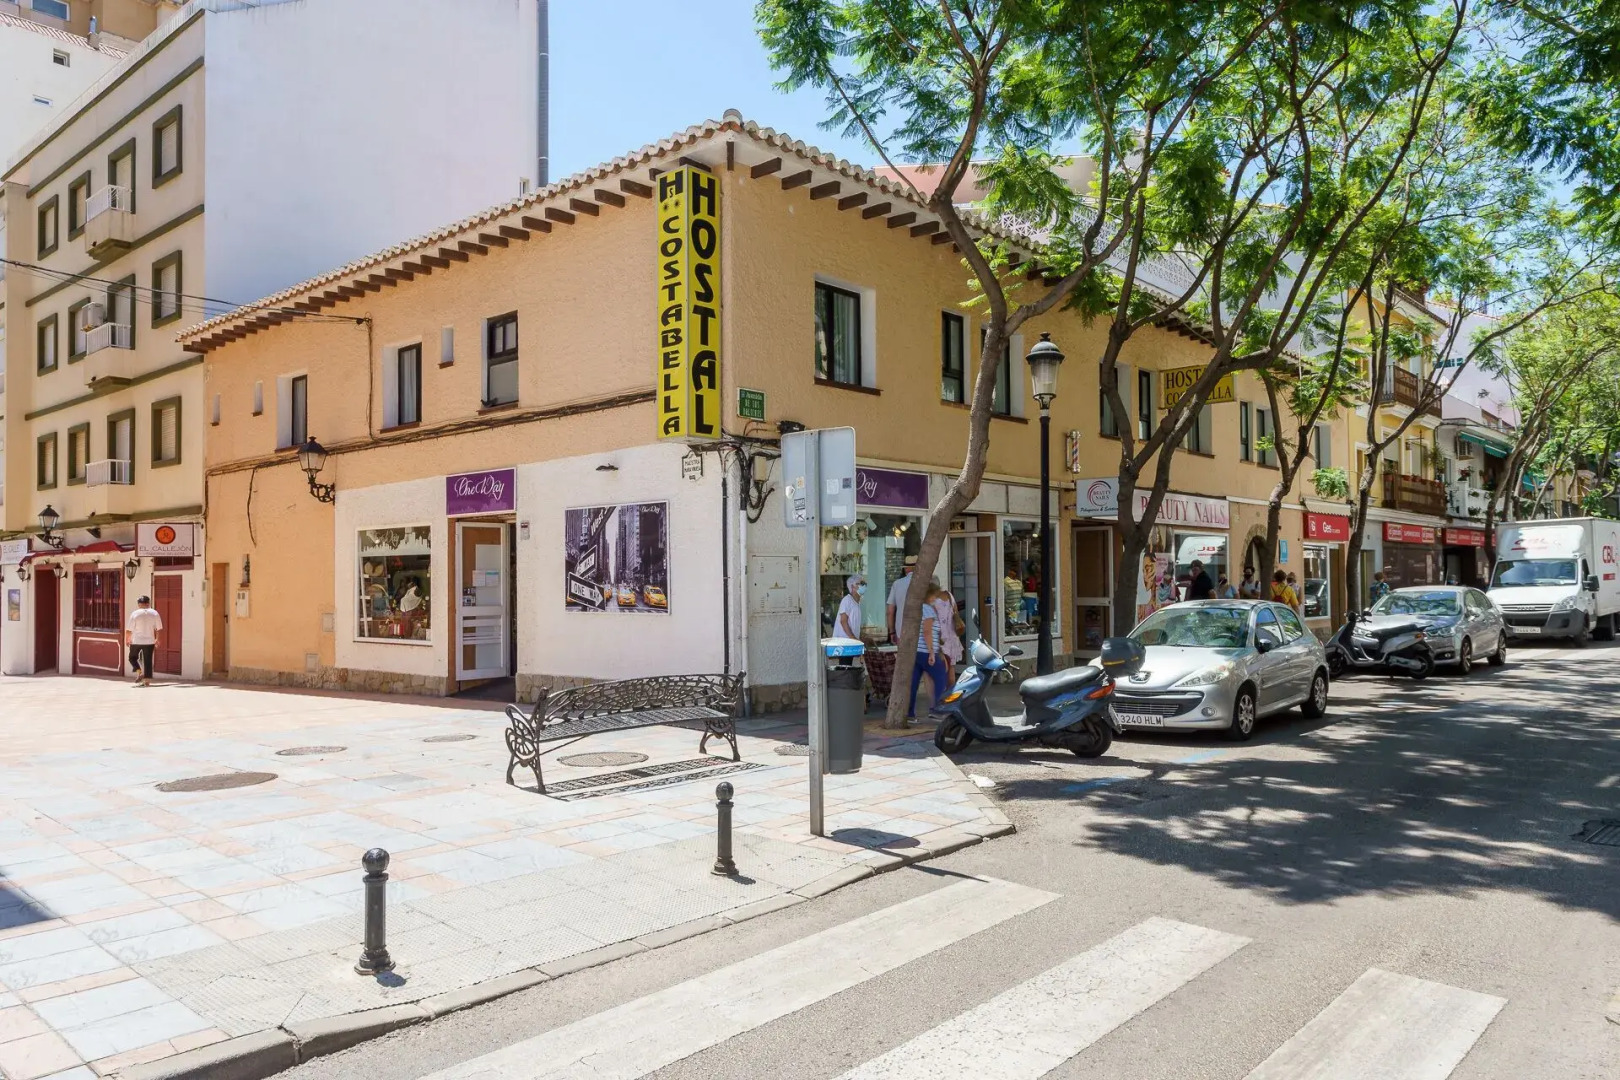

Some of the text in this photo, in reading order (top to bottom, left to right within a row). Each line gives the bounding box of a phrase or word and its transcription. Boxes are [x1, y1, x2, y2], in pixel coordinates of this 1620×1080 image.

[691, 171, 717, 435] HOSTAL
[660, 215, 683, 436] COSTABELLA
[1166, 386, 1232, 405] COLLA
[475, 475, 505, 501] Way
[1141, 496, 1226, 524] BAUTY NAILS
[573, 582, 585, 596] ONE
[1120, 714, 1162, 725] 3240 HLM
